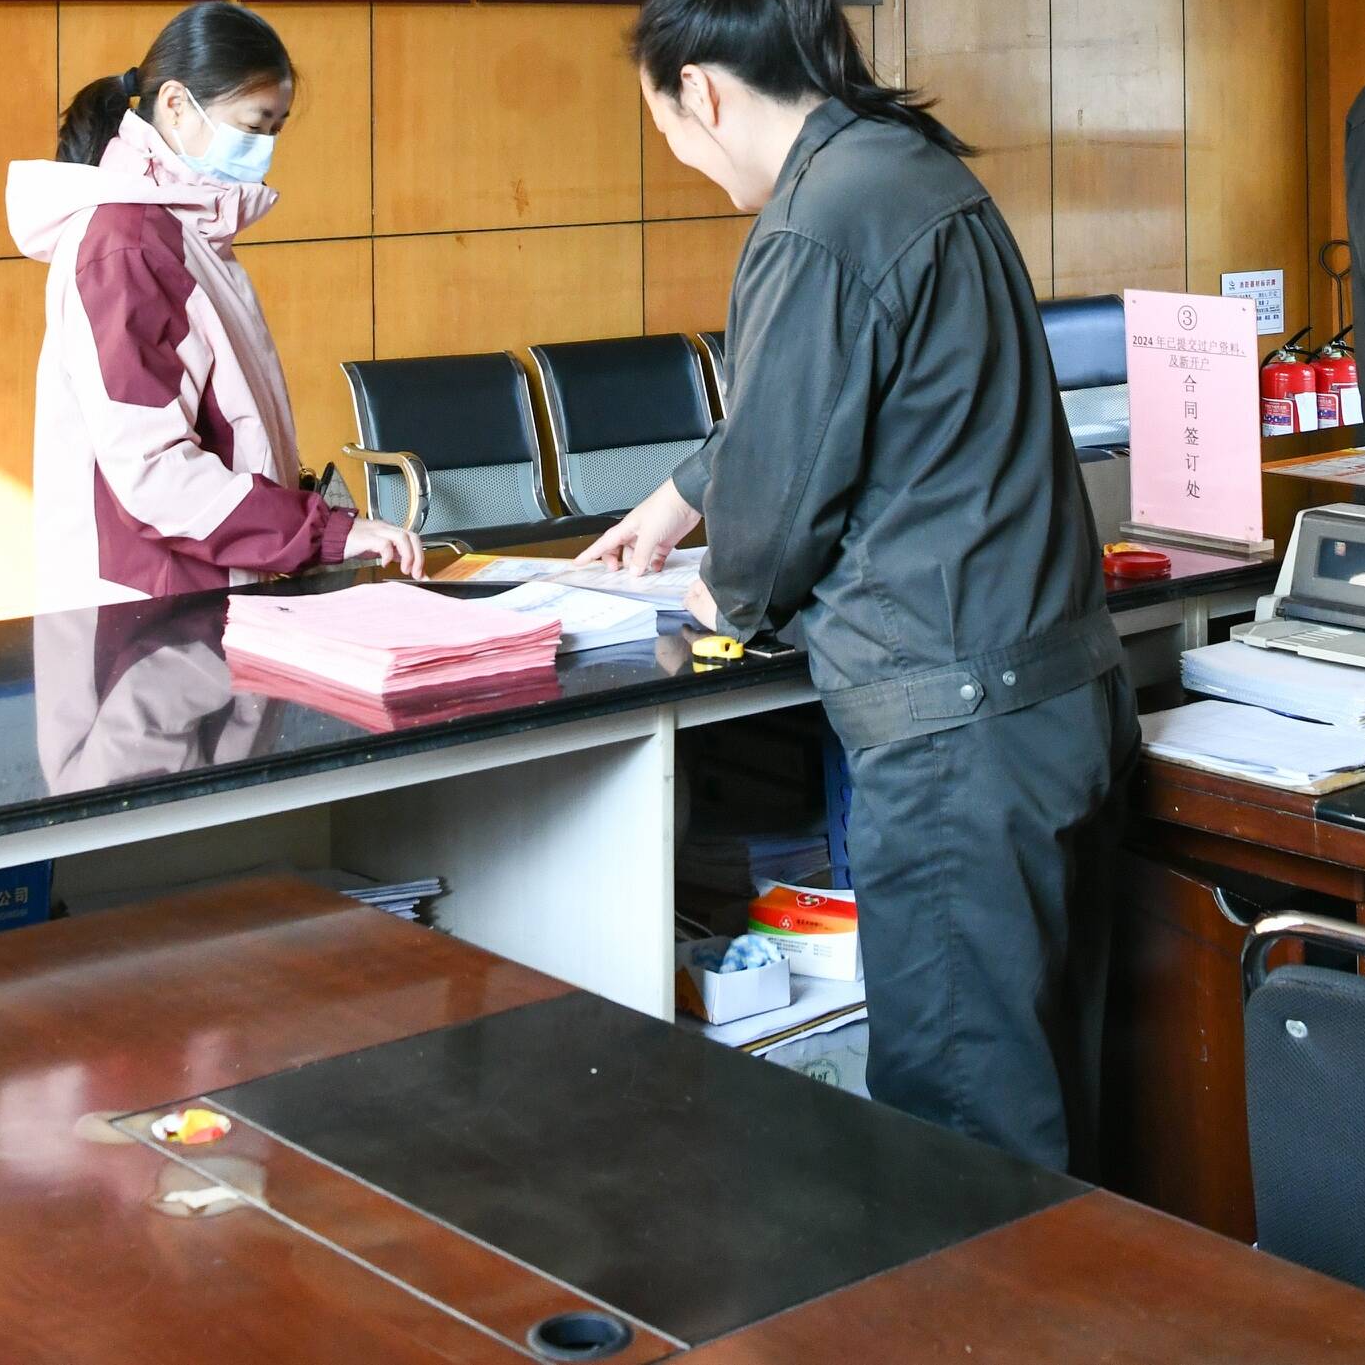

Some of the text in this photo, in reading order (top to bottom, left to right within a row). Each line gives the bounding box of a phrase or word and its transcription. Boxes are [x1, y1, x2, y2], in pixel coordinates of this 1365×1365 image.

[1183, 374, 1200, 499] 合同签订处
